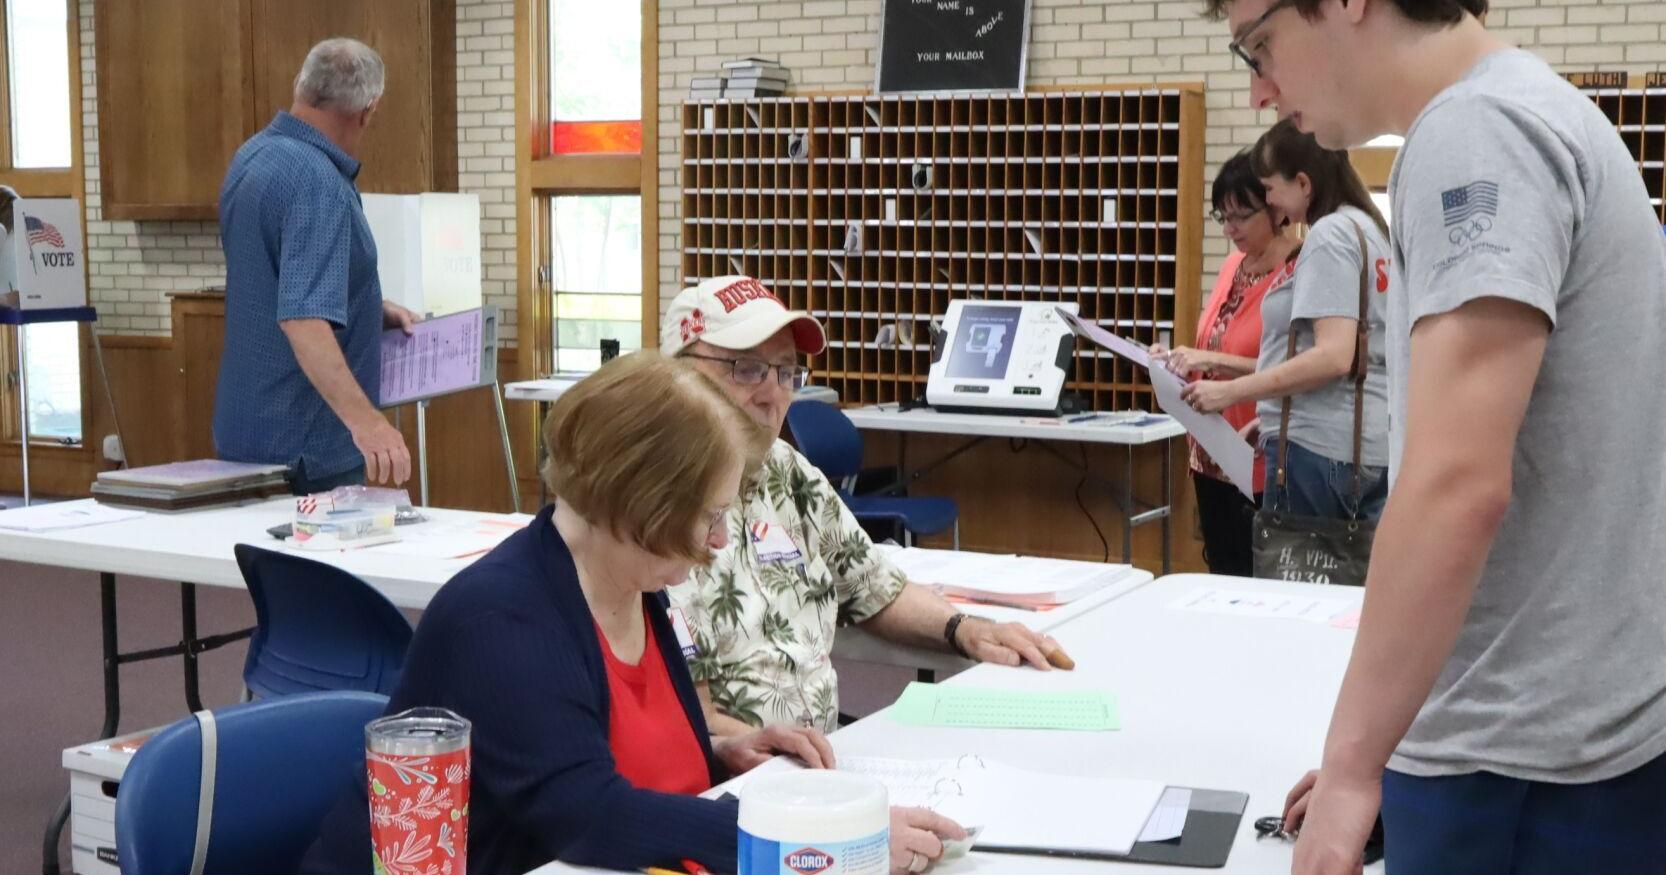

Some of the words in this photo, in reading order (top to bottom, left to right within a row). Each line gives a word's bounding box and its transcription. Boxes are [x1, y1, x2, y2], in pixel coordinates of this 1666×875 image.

[937, 1, 960, 11] NAME
[965, 6, 974, 16] IS
[975, 11, 1004, 38] ABOVE
[917, 52, 940, 62] YOUR
[945, 50, 984, 61] MAILBOX
[41, 252, 75, 267] VOTE
[789, 854, 828, 868] CLOROX
